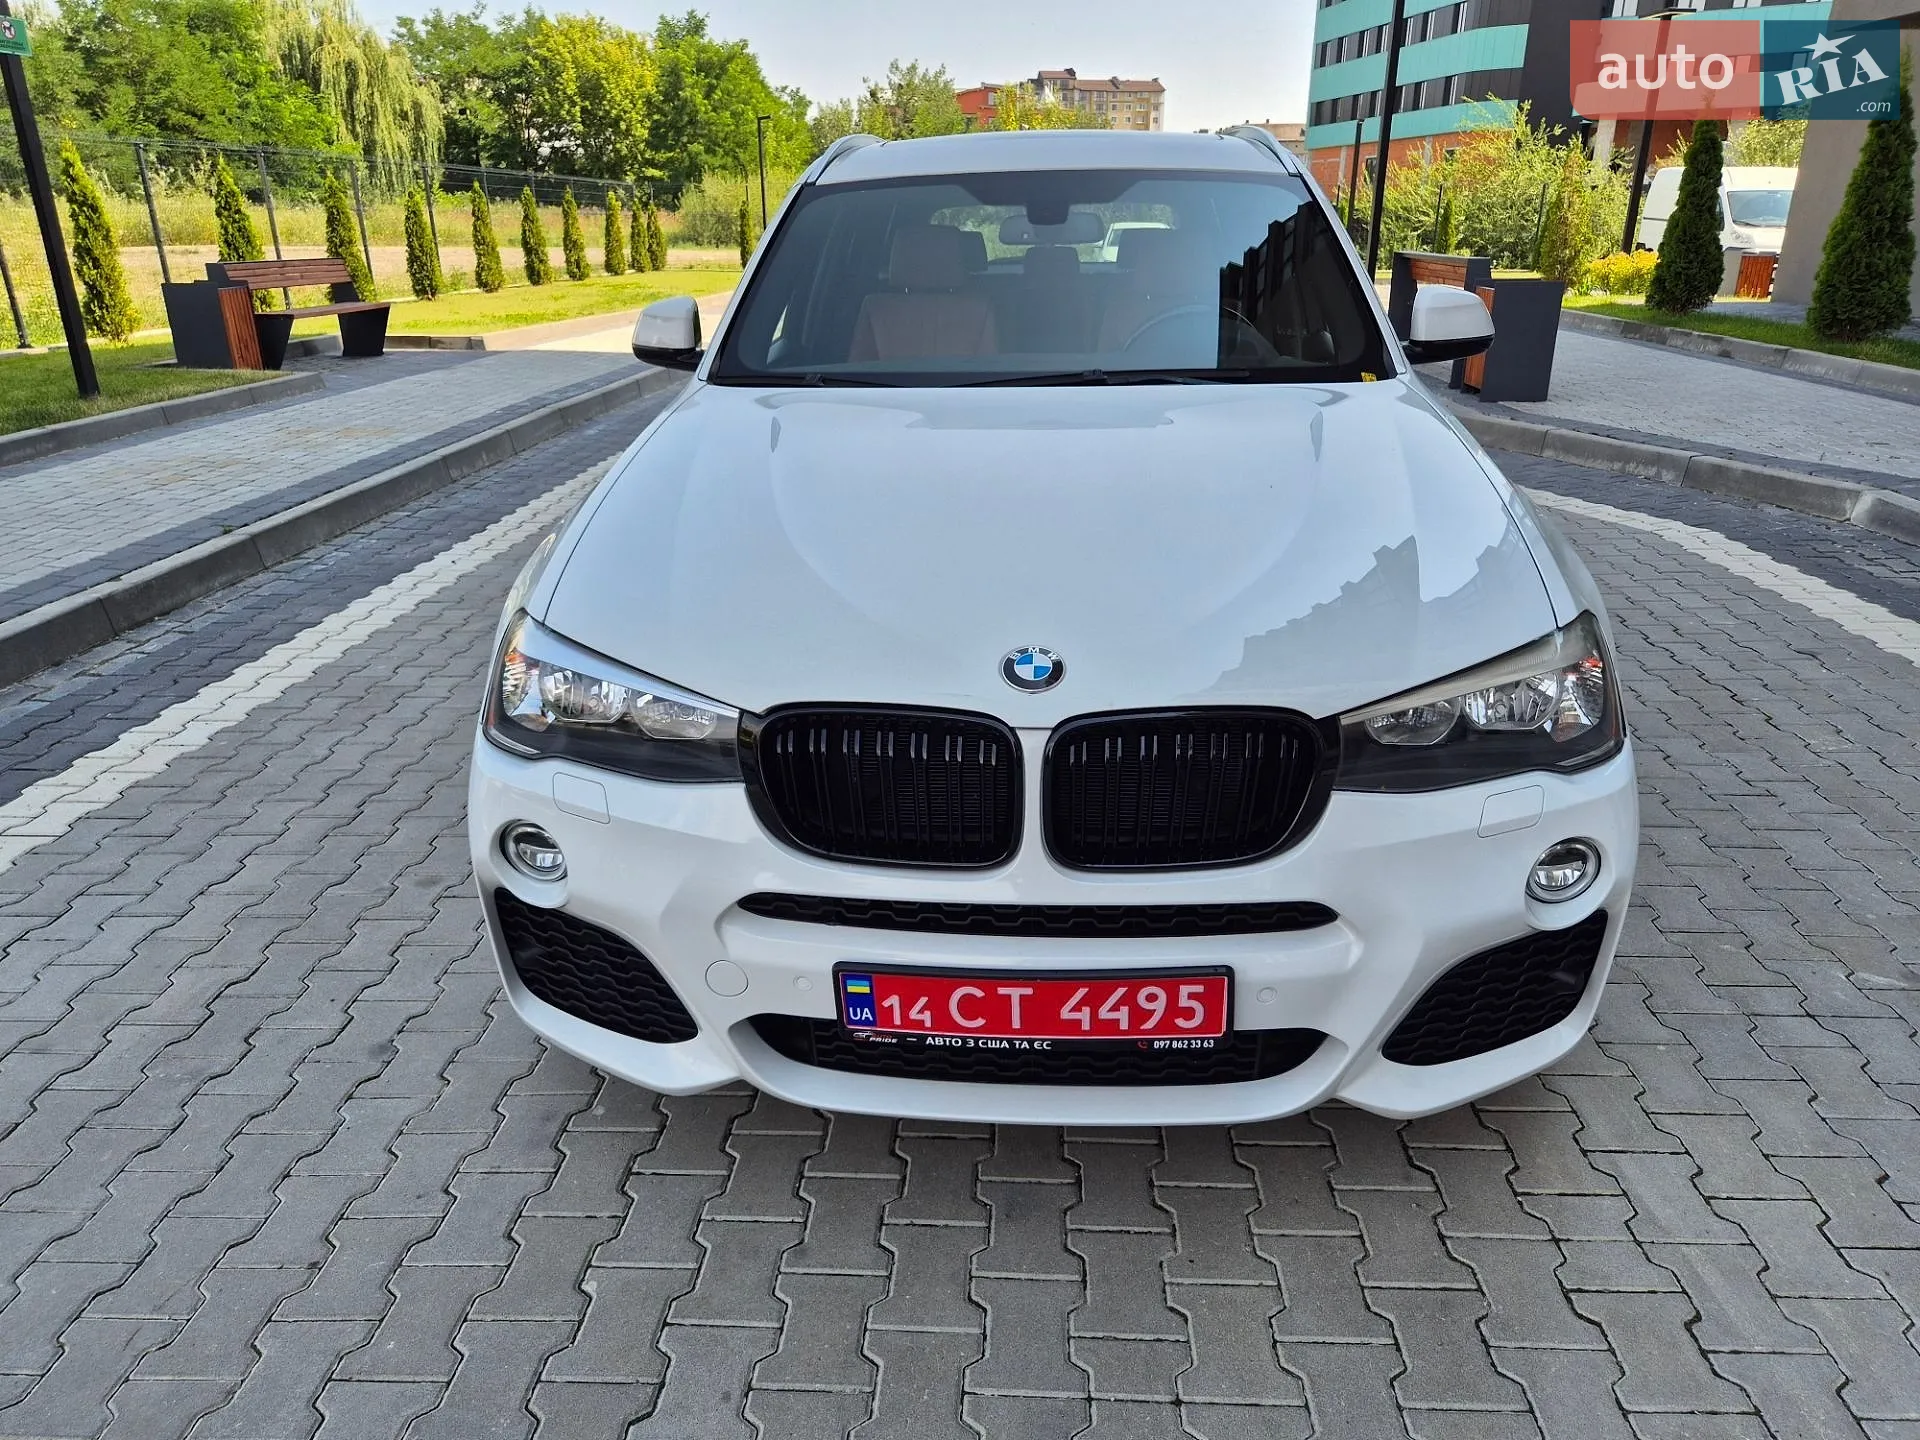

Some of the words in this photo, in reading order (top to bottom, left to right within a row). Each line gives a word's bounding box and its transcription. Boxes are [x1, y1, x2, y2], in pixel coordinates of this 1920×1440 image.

[1009, 647, 1061, 661] BMW
[849, 1007, 873, 1021] UA
[881, 994, 932, 1028] 14
[1060, 985, 1205, 1030] 4495
[925, 1036, 962, 1047] АВТО
[978, 1039, 1009, 1049] США
[1013, 1040, 1030, 1049] ТА
[1033, 1041, 1052, 1050] ЄС
[1153, 1040, 1170, 1049] 097
[1171, 1040, 1188, 1049] 862
[1190, 1040, 1201, 1049] 33
[1203, 1039, 1214, 1048] 63
